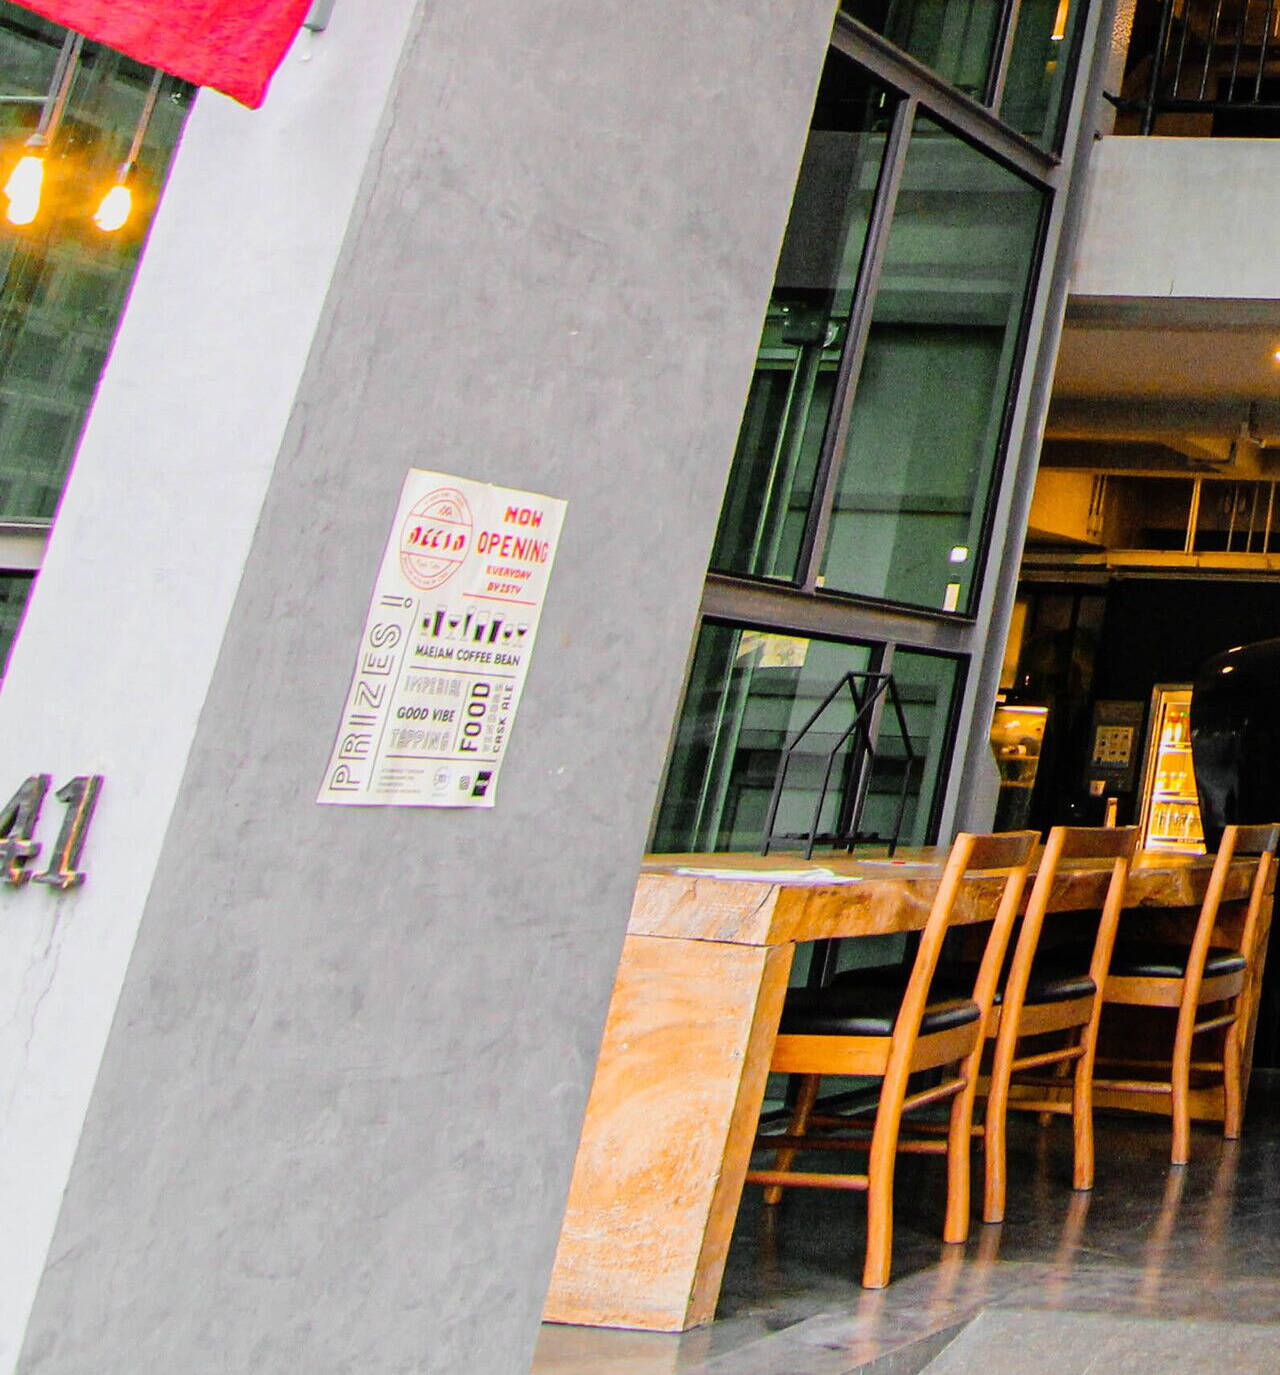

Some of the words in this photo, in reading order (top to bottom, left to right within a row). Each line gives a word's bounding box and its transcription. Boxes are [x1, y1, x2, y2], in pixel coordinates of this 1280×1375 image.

[503, 505, 543, 528] NOW
[477, 530, 550, 564] OPENING
[485, 564, 532, 579] EVERYDAY
[457, 648, 493, 664] COFFEE
[493, 652, 521, 667] BEAN
[397, 706, 430, 721] GOOD
[432, 708, 456, 723] VIBE
[459, 681, 491, 753] FOOD
